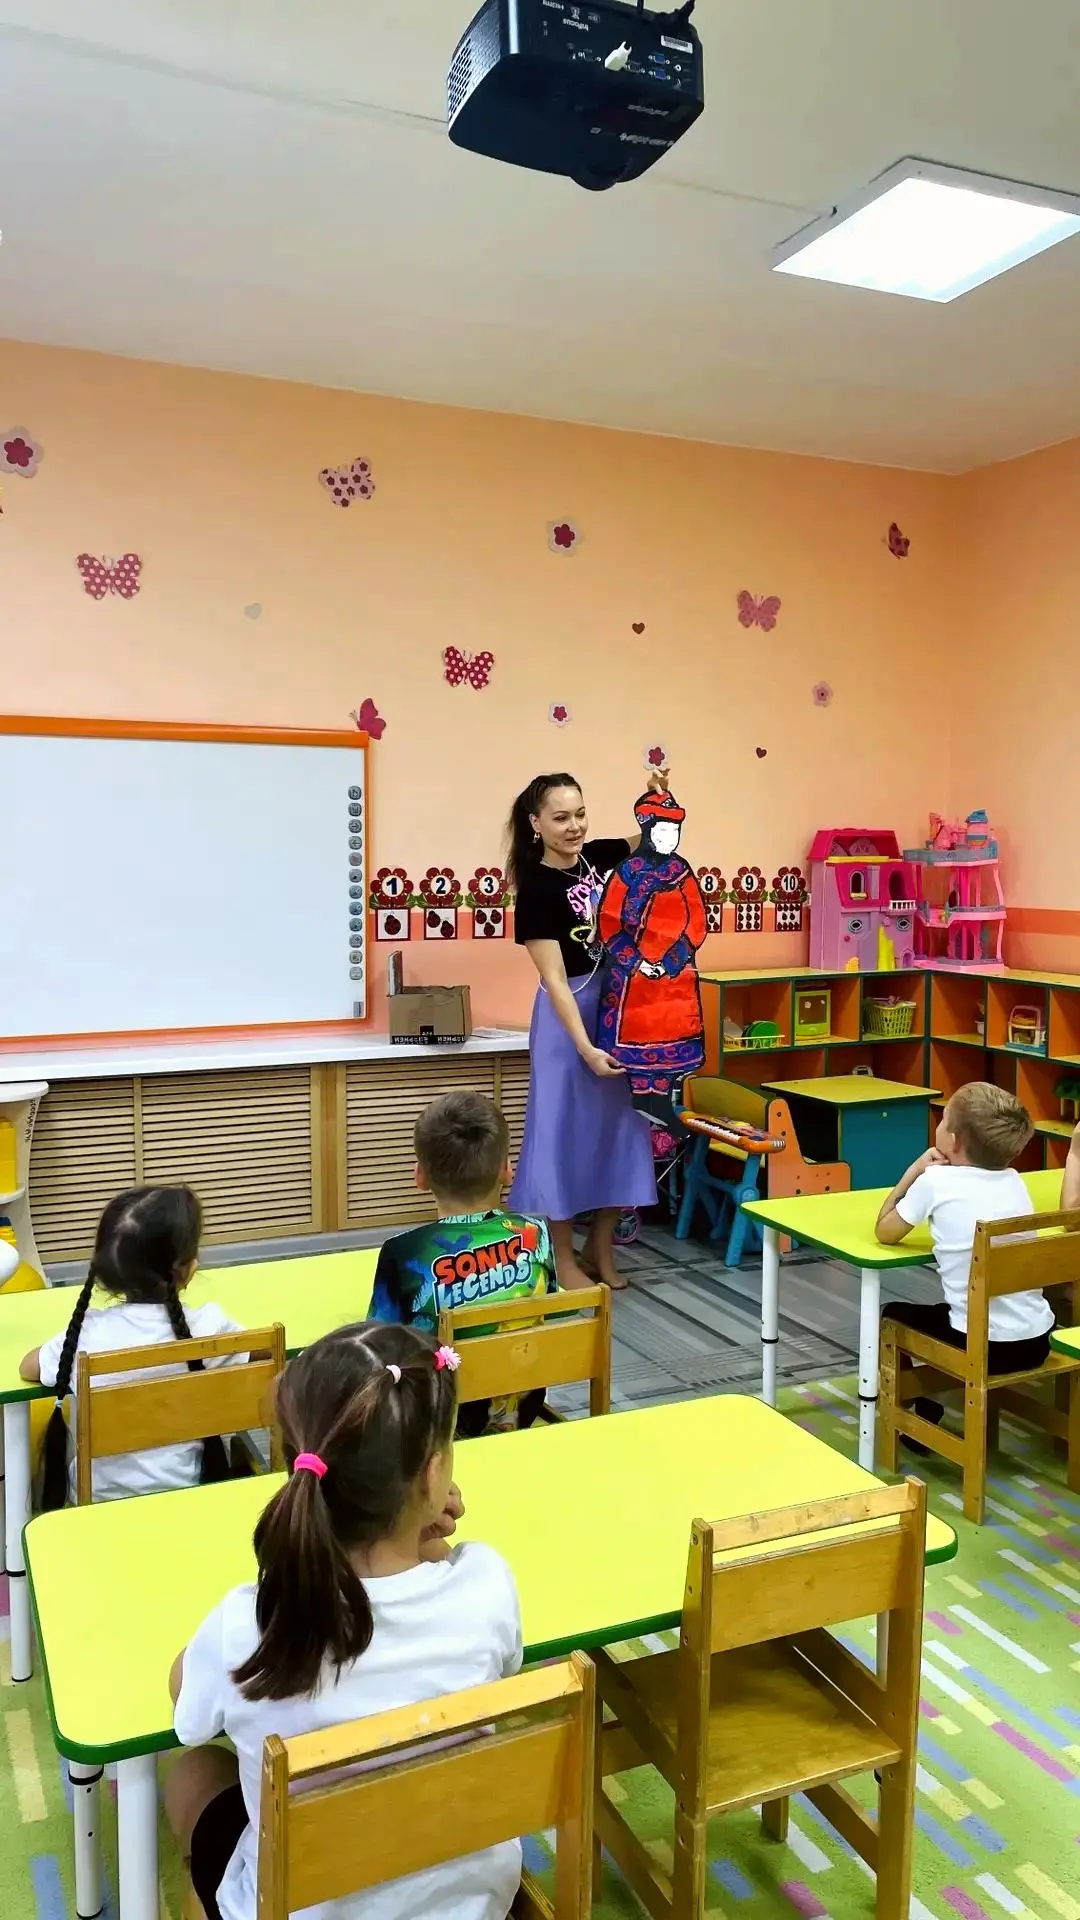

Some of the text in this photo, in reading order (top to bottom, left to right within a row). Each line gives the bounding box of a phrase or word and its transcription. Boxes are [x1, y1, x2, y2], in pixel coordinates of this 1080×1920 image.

[386, 877, 398, 895] 1
[435, 877, 446, 895] 2
[484, 876, 494, 894] 3
[704, 875, 714, 892] 8
[745, 874, 754, 891] 9
[783, 875, 796, 891] 10
[435, 1238, 522, 1285] SONIC
[437, 1252, 531, 1311] LEGENDS
